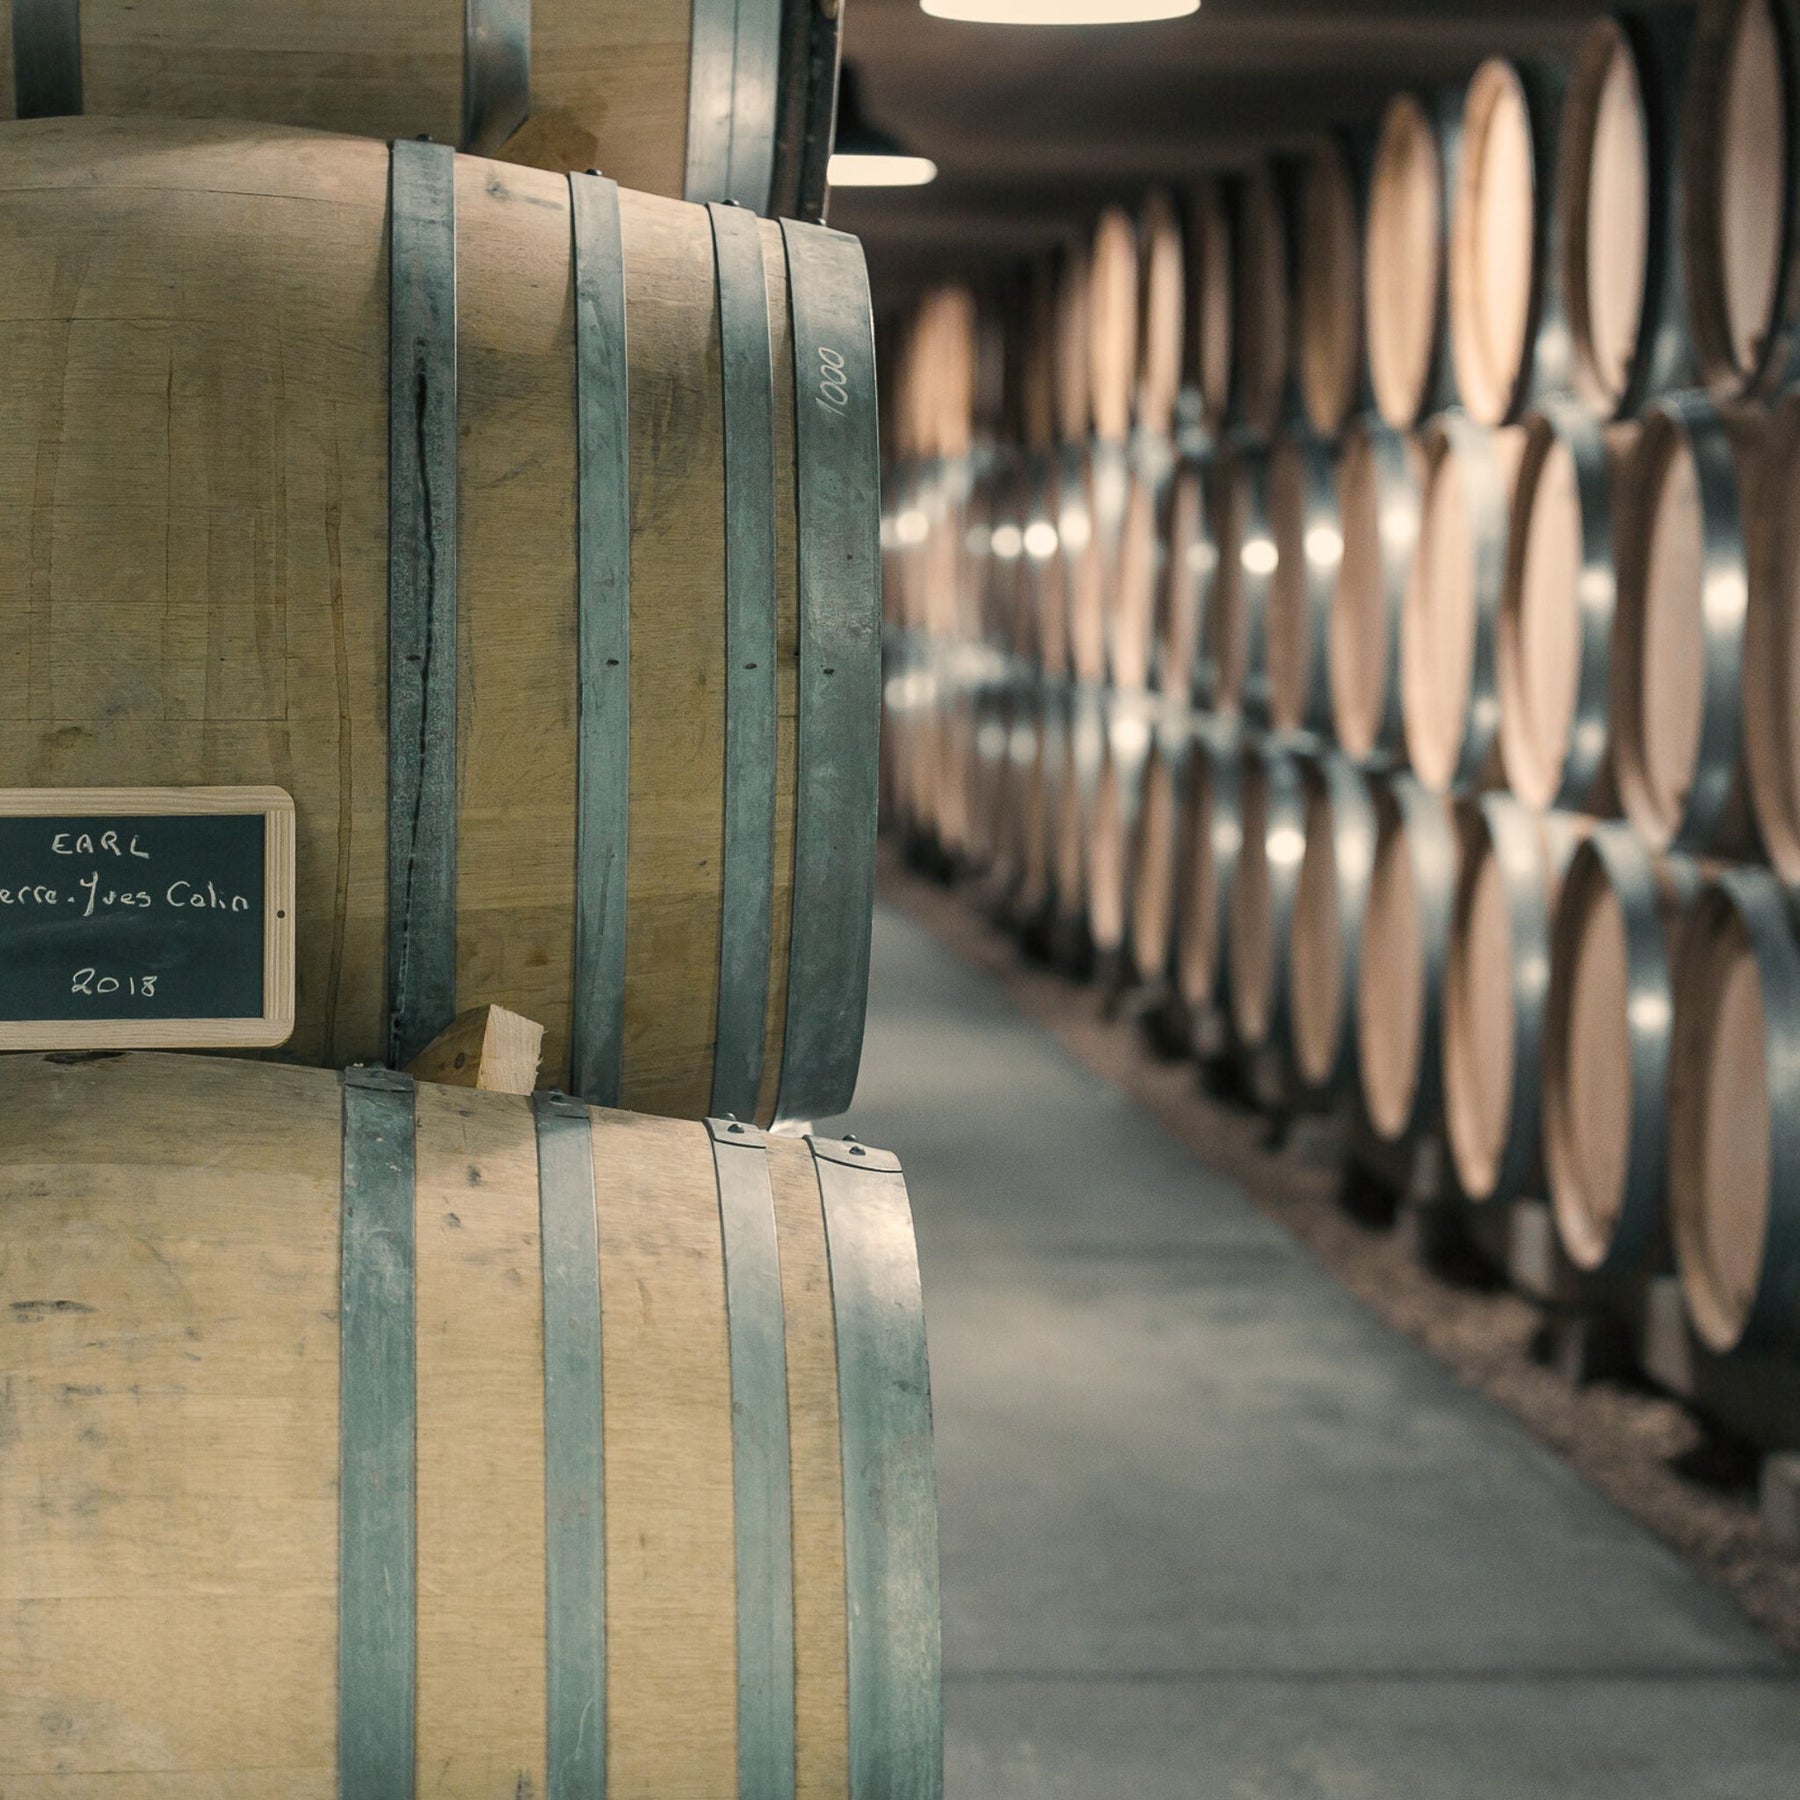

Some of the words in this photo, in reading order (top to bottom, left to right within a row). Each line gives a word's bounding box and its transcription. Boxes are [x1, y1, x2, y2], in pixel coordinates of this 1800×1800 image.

[815, 346, 850, 420] 1000
[52, 830, 150, 859] EARL
[71, 967, 158, 997] 2018
